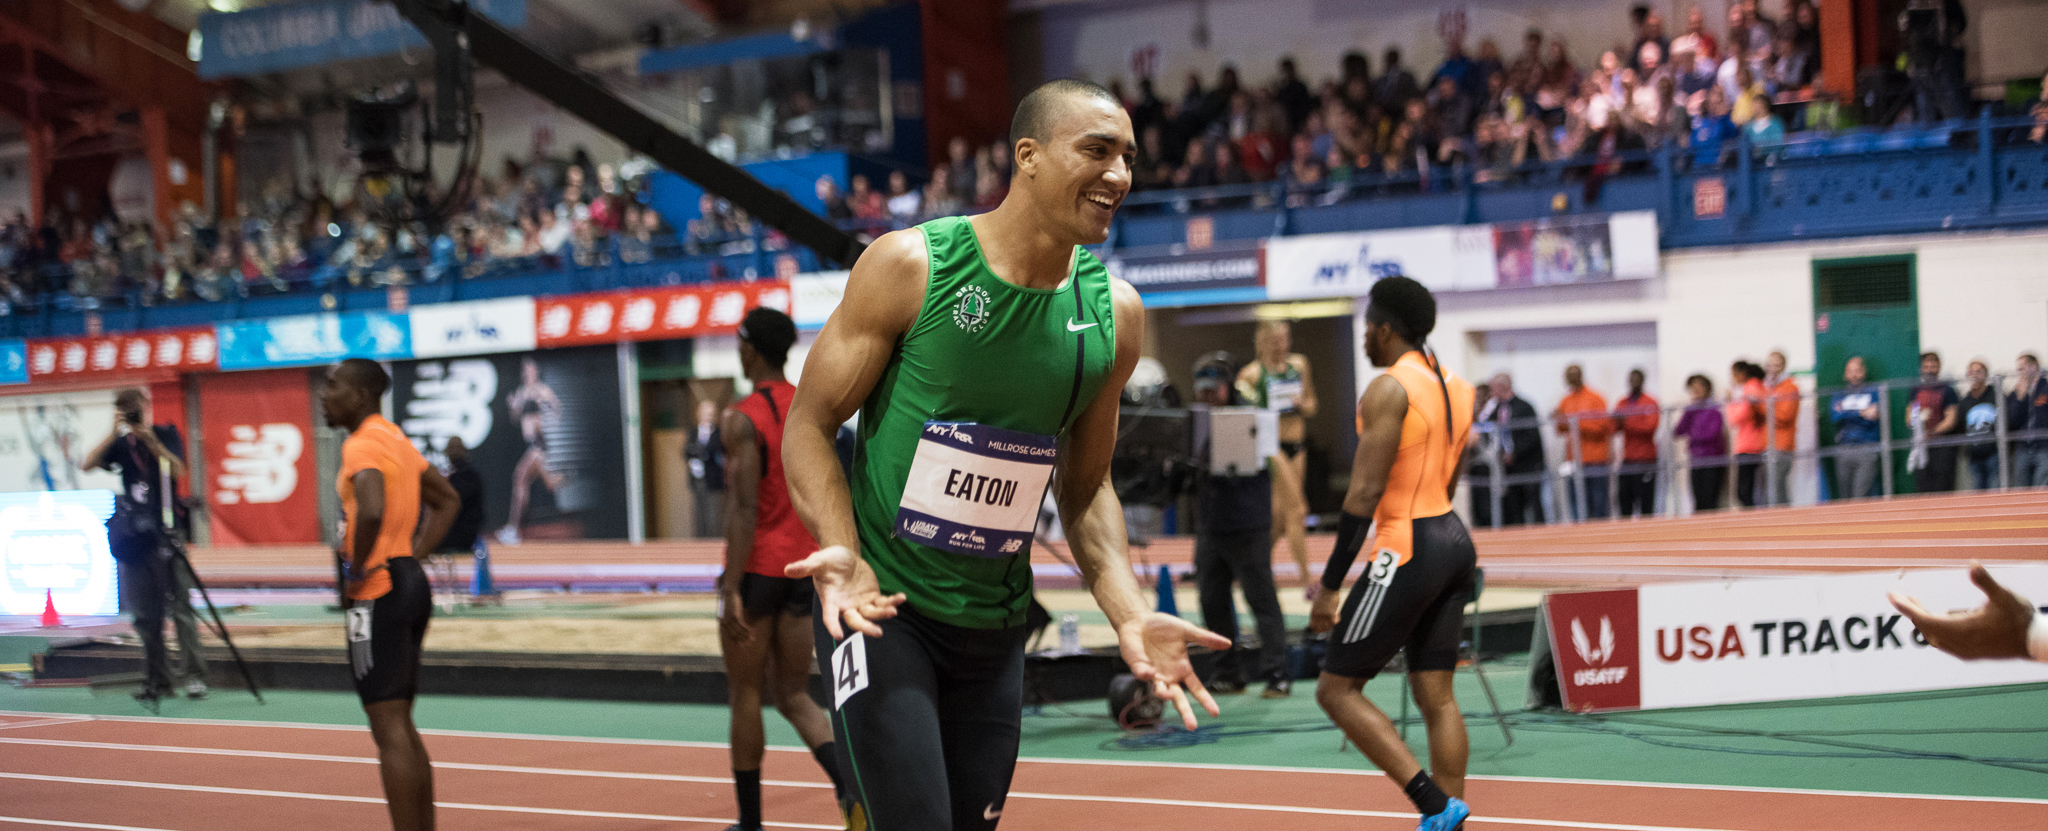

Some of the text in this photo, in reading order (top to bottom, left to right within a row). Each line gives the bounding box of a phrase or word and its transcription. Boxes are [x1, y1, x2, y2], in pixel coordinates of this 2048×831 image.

[955, 284, 991, 304] OREGON
[952, 304, 966, 329] TRACK
[972, 311, 990, 333] CLUB
[987, 440, 1057, 458] MILLROSE GAMES
[944, 468, 1018, 507] EATON
[948, 539, 961, 547] RUN
[1373, 552, 1393, 579] 3
[353, 611, 366, 638] 2
[1655, 624, 1746, 664] USA
[1753, 614, 1903, 657] TRACK
[838, 641, 860, 692] 4
[1573, 666, 1629, 687] USATF
